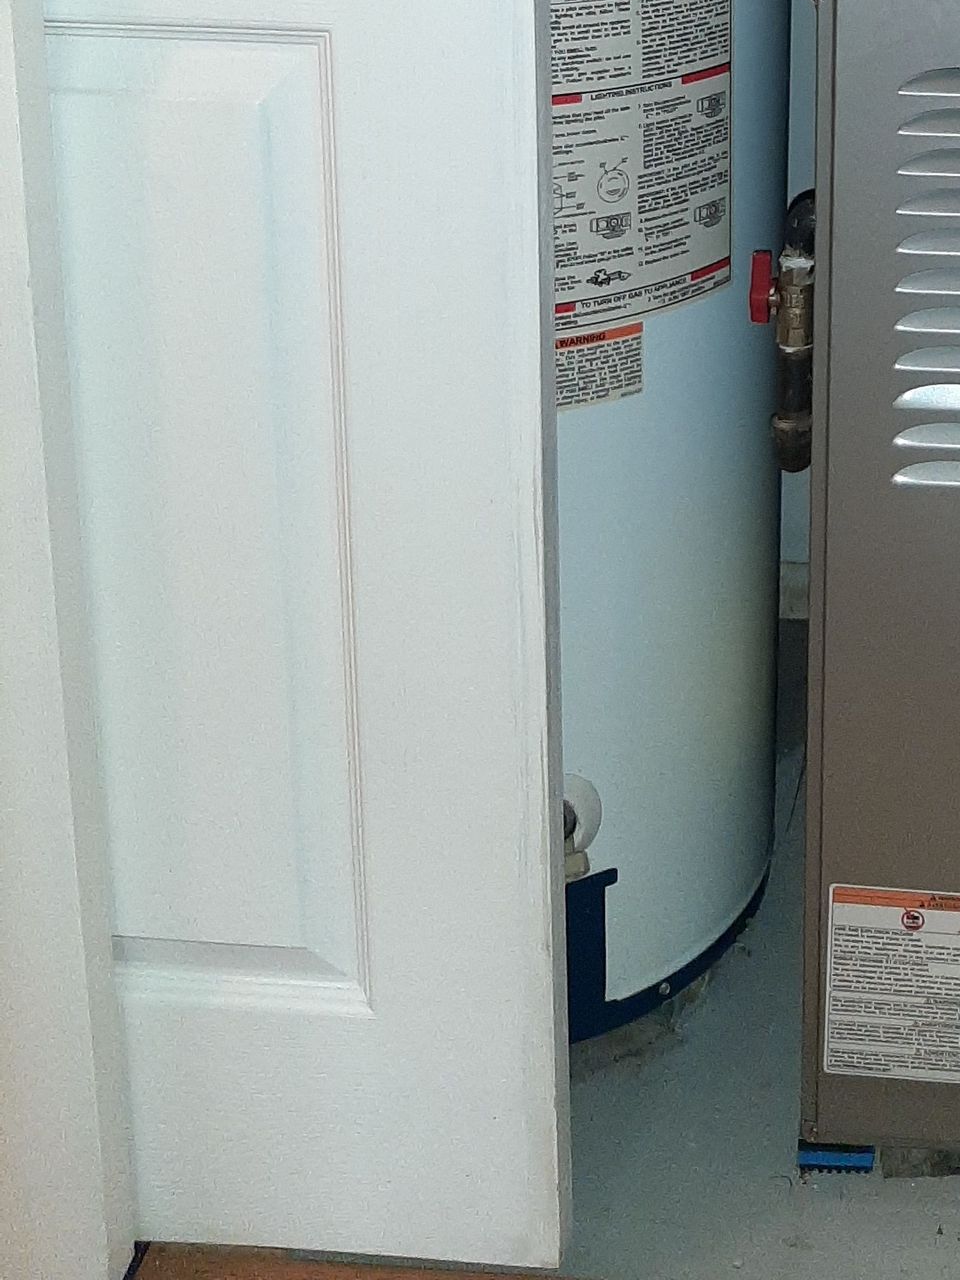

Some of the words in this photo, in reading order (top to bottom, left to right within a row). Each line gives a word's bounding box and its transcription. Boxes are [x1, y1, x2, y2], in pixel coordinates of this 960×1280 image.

[593, 297, 613, 307] TURN
[613, 293, 627, 303] OFF
[628, 290, 643, 300] GAS
[560, 331, 606, 347] WARNING
